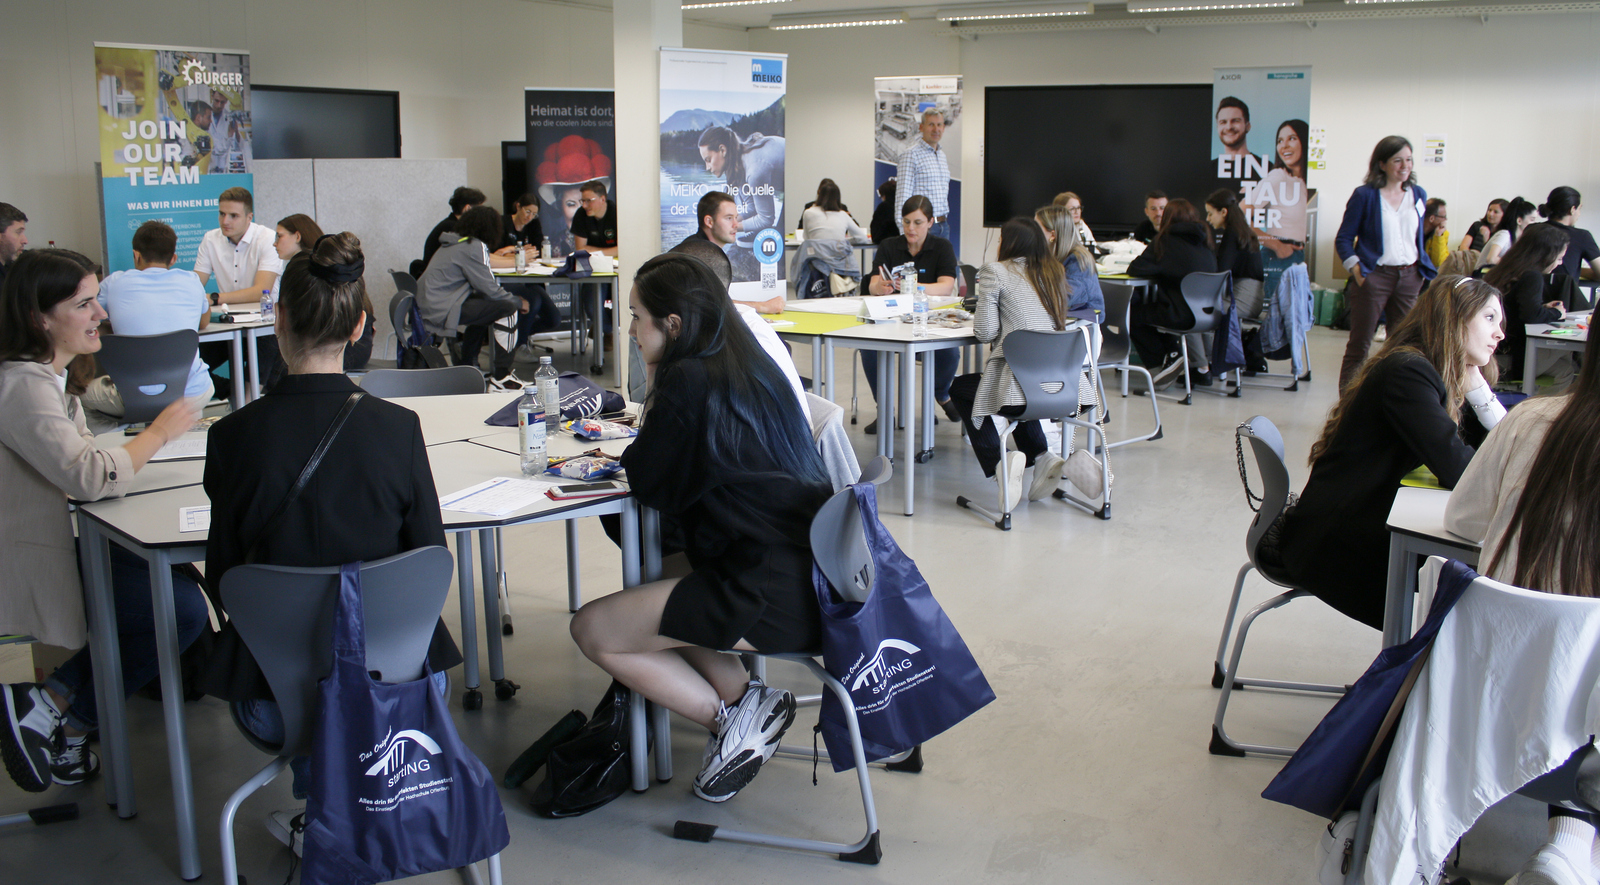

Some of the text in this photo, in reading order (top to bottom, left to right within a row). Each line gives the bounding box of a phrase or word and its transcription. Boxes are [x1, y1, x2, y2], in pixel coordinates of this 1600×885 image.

[194, 72, 244, 86] BURGER
[752, 74, 782, 83] MEIKO
[530, 104, 614, 118] Heimat ist dort,
[122, 120, 187, 140] JOIN
[124, 143, 183, 163] OUR
[1217, 154, 1269, 178] EIN
[124, 166, 200, 186] TEAM
[670, 183, 774, 197] MEIKO Die Quelle
[1240, 181, 1301, 206] TAU
[127, 202, 149, 210] WAS
[150, 201, 170, 209] WIR
[172, 200, 202, 208] IHNEN
[670, 203, 689, 215] der
[756, 230, 780, 242] HYGIENE
[562, 293, 570, 301] by
[359, 752, 373, 762] Das
